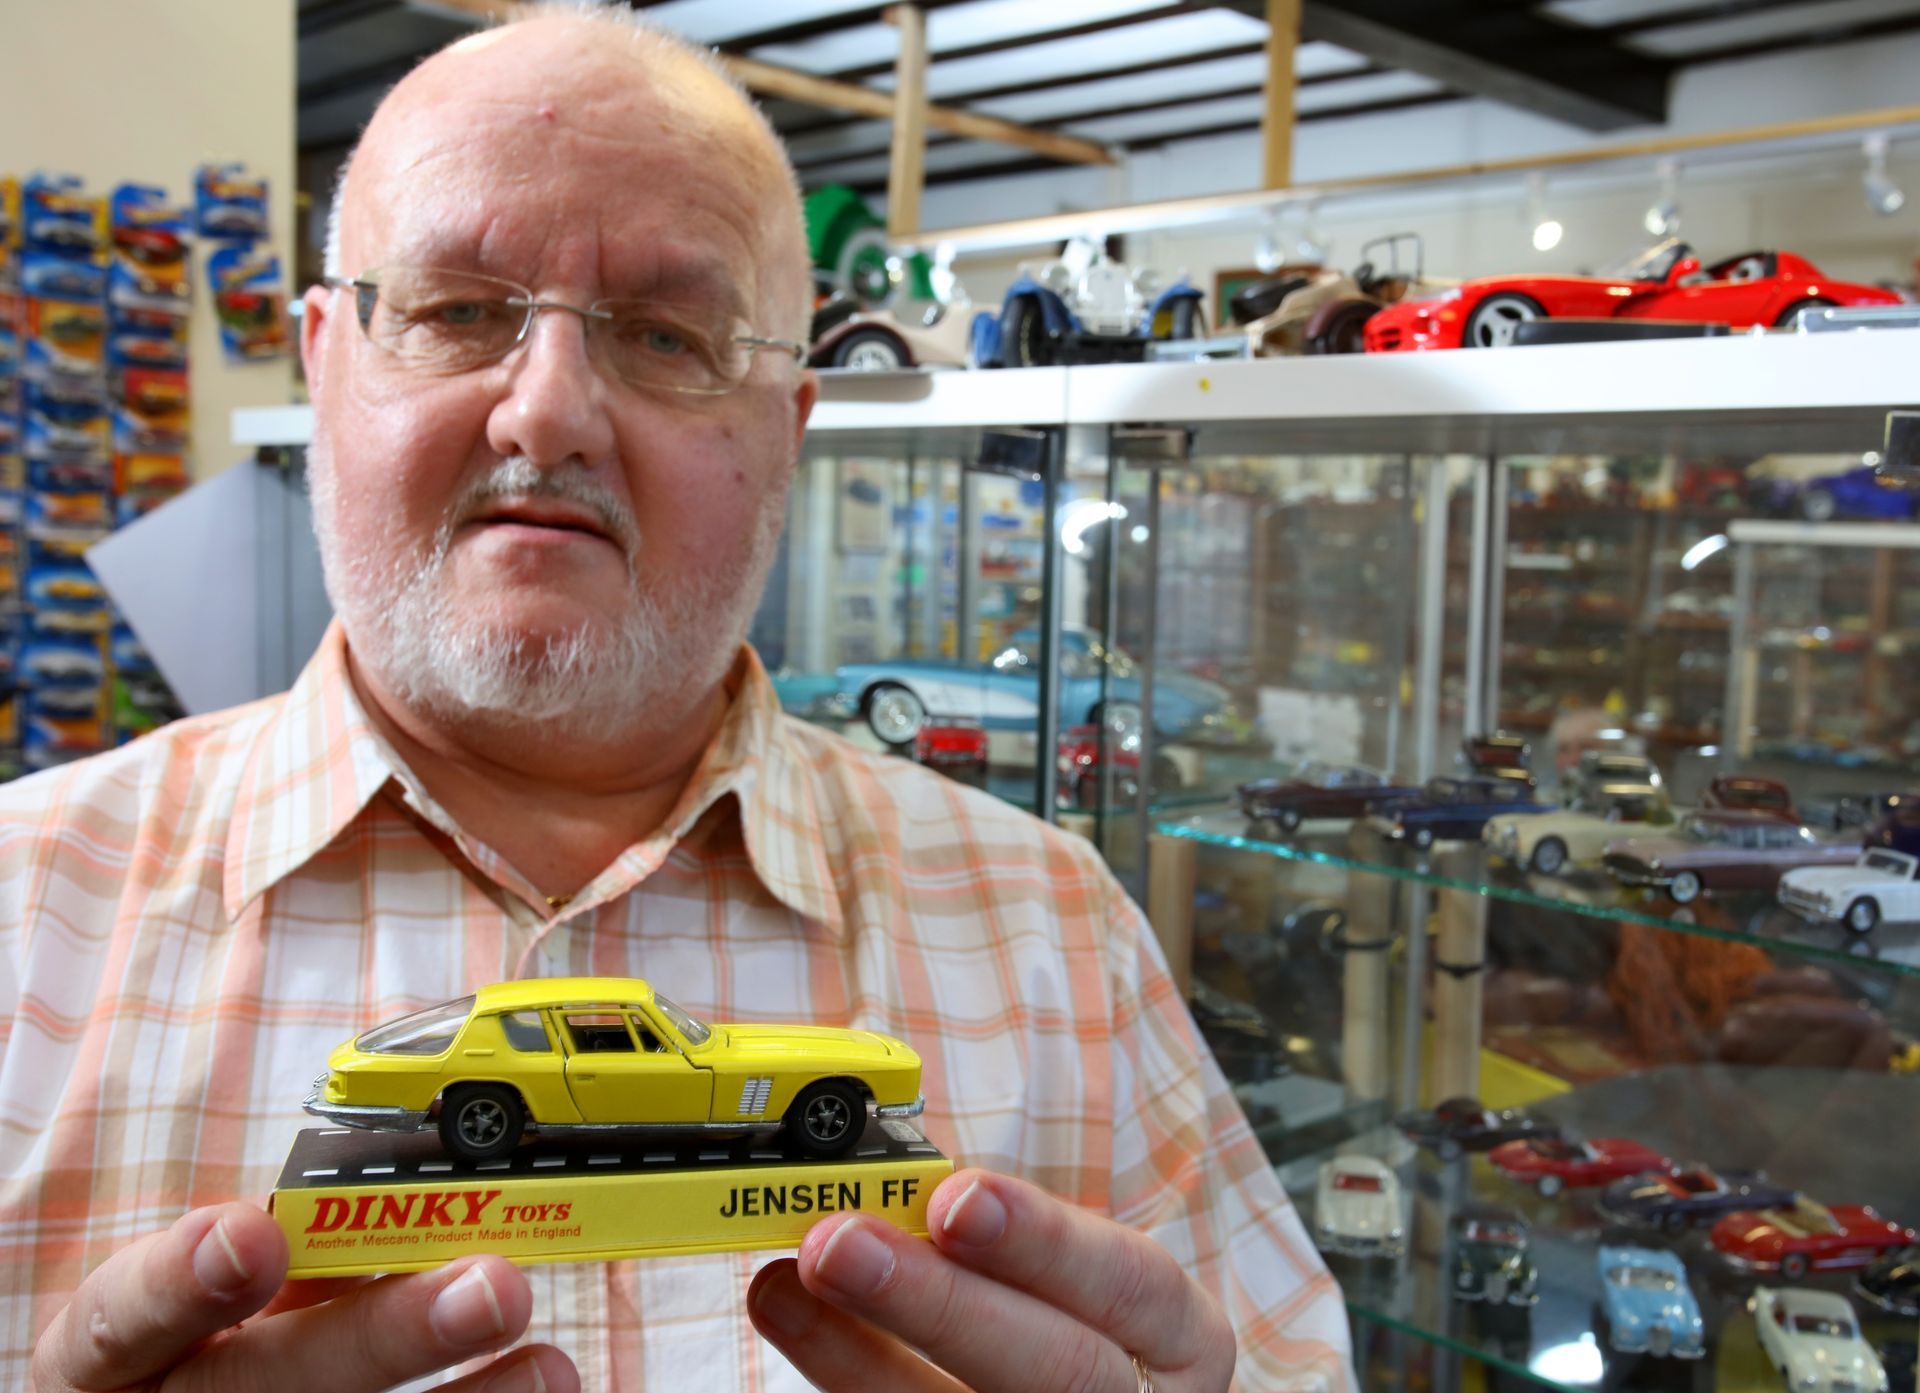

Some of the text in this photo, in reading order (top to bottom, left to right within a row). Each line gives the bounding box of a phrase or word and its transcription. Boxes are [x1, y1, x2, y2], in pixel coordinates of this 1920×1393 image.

[304, 1190, 573, 1235] DINKY TOYS
[719, 1178, 920, 1218] JENSEN FF
[305, 1225, 581, 1250] Another Meccano Product Made in England
